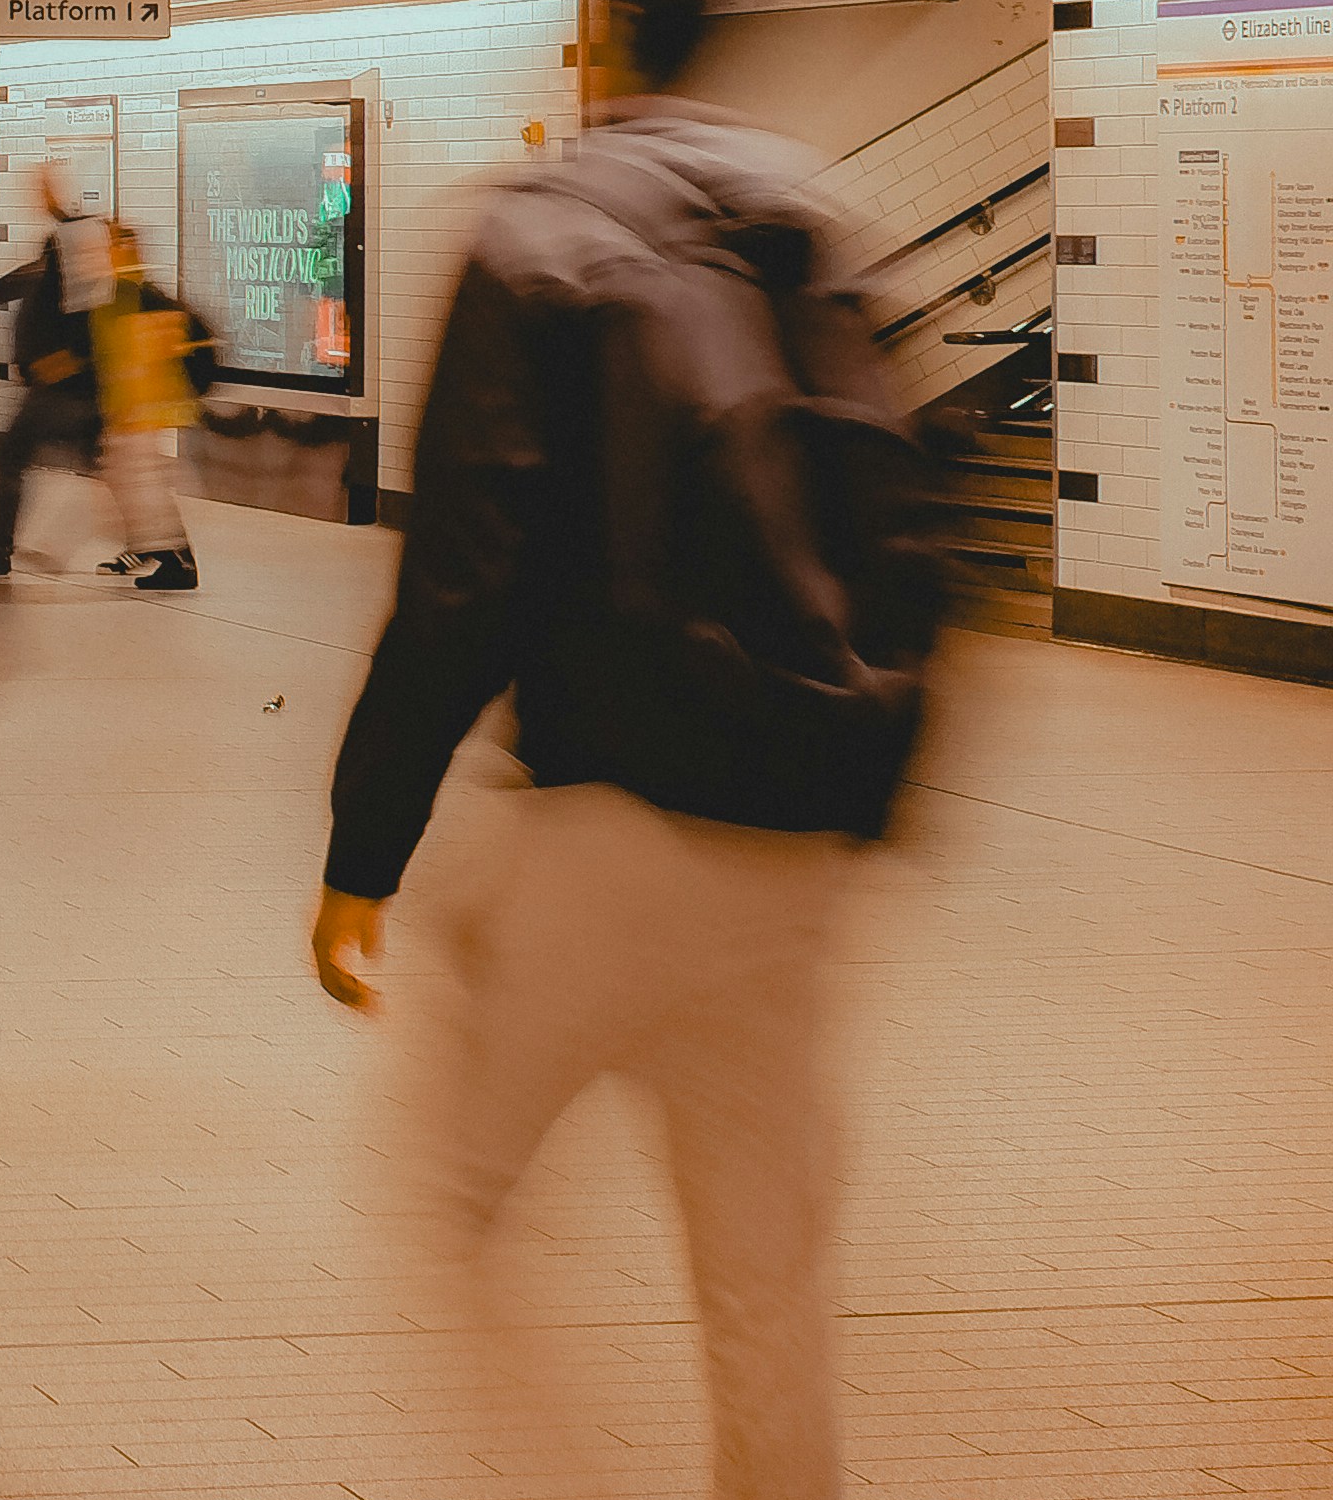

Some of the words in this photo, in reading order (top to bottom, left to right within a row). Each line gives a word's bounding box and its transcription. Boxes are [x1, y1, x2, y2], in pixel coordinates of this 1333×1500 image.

[9, 0, 116, 21] Platform
[1241, 16, 1302, 38] Elizabeth
[1306, 15, 1331, 35] line
[1173, 97, 1227, 117] Platform
[1231, 96, 1238, 115] 2
[207, 208, 236, 242] THE
[237, 209, 309, 245] WORLD'S
[226, 246, 269, 282] MOST
[245, 284, 281, 322] RIDE
